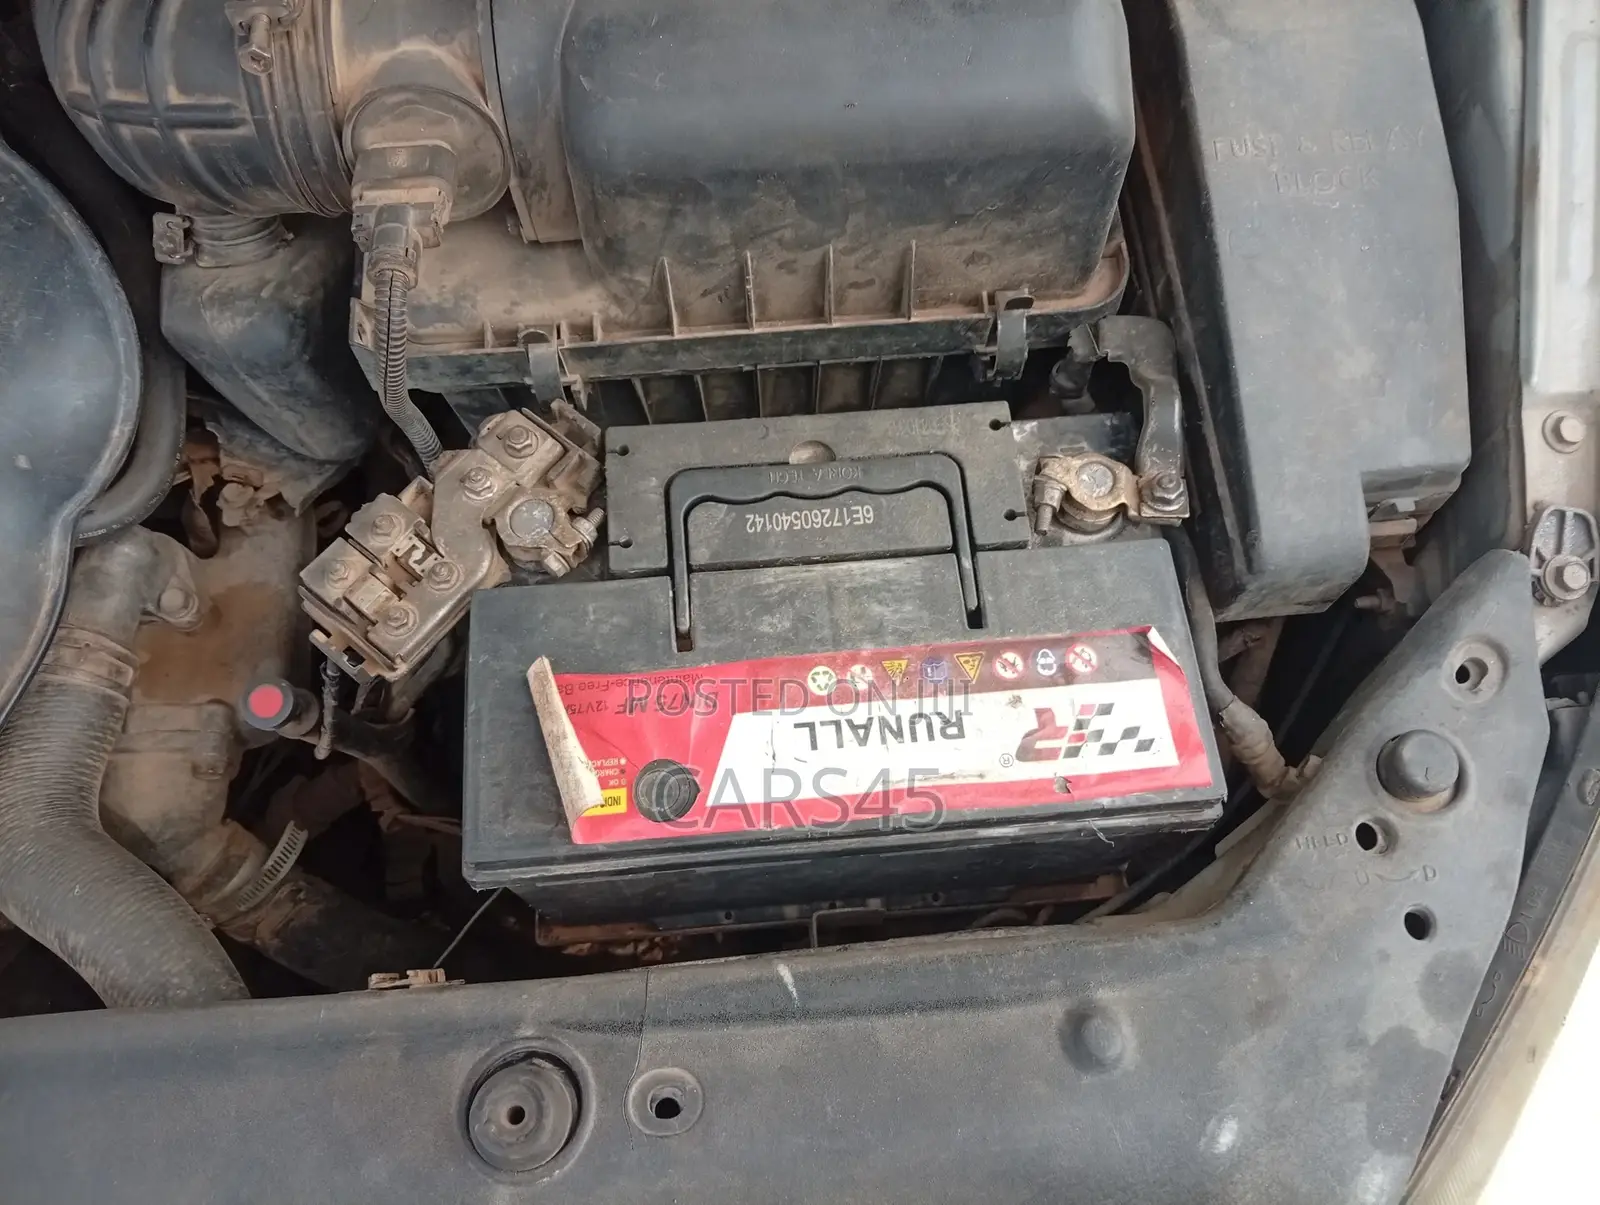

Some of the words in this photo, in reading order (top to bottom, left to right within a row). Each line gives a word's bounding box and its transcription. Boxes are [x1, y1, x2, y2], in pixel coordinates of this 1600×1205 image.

[1273, 165, 1381, 196] BLOCK
[745, 504, 875, 534] 6E17260540142
[794, 709, 965, 751] RUNALL
